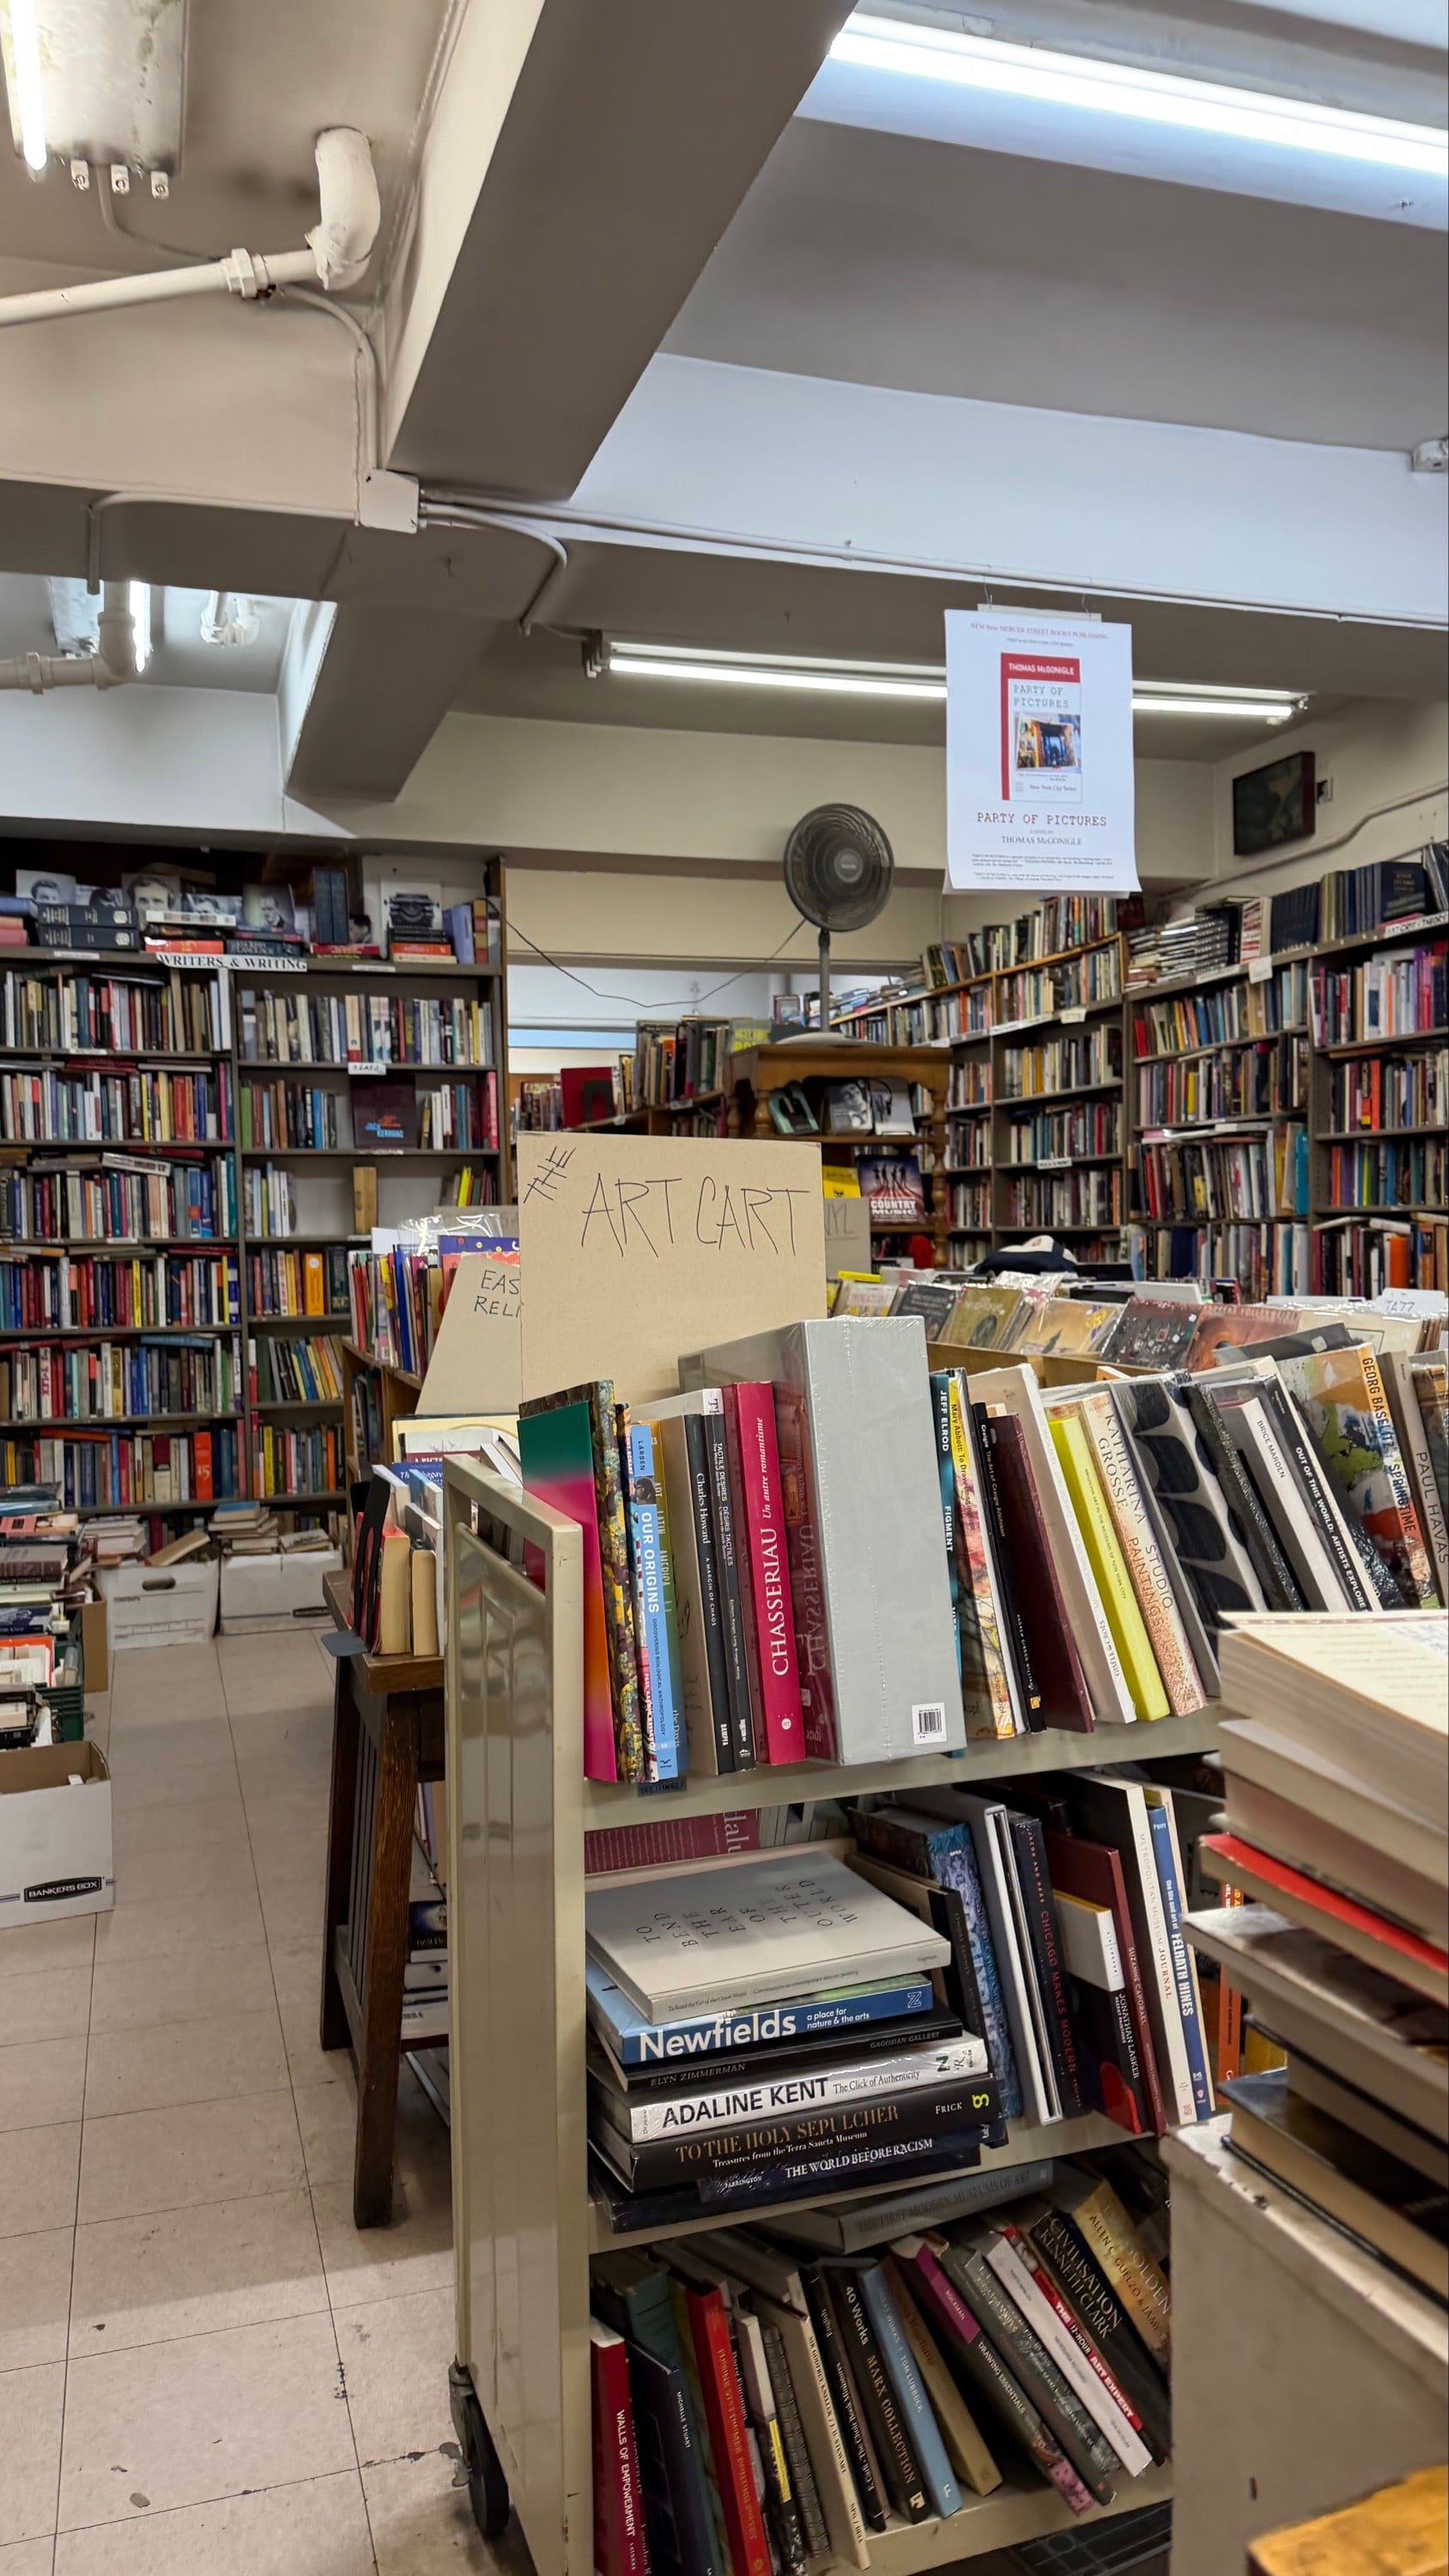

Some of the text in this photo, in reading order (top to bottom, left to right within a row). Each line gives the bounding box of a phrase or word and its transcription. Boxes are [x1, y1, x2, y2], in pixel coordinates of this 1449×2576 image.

[1009, 662, 1035, 672] THOMAS
[1014, 684, 1064, 696] PARTY OF
[1014, 697, 1069, 708] PICTURES
[977, 812, 1106, 826] PARTY OF PICTURES
[1002, 835, 1035, 844] THOMAS
[158, 953, 306, 970] WRITERS & WRITING
[581, 1173, 810, 1257] ART CART
[870, 1200, 916, 1210] COUNTRY
[1362, 1358, 1380, 1394] GEORG
[637, 1440, 646, 1472] LARSEN
[941, 1418, 949, 1452] ELROD
[1257, 1420, 1287, 1479] BRICE MARDEN
[716, 1442, 728, 1501] TACTILE DESIRES
[755, 1418, 773, 1519] Un autre romantisme
[1098, 1437, 1129, 1510] GROSSE
[1105, 1414, 1148, 1525] KATHARINA
[696, 1473, 712, 1545] Charles Howard
[722, 1505, 734, 1566] DÉSIRS TACTILES
[944, 1505, 954, 1552] FIGMENT
[1294, 1447, 1367, 1609] OUT OF THIS WORLD: ARTISTS EXPLORE
[1416, 1451, 1448, 1564] PAUL HAVAS
[641, 1512, 660, 1614] OUR ORIGINS
[1127, 1537, 1166, 1629] PAINTINGS
[1145, 1545, 1174, 1608] STUDIO
[709, 1592, 714, 1601] OF
[762, 1528, 790, 1676] CHASSERIAU
[27, 1879, 99, 1899] BANKERS BOX
[1139, 1832, 1159, 1906] METROPOLITAN
[1158, 1947, 1173, 2000] JOURNAL
[1040, 1910, 1077, 2075] CHICAGO MAKES MODERN
[1126, 1945, 1140, 1986] SUZANNE
[1171, 1934, 1194, 2017] FELRATH HINES
[640, 2009, 797, 2062] Newfields
[807, 2019, 832, 2030] nature
[841, 2014, 853, 2024] the
[855, 2012, 870, 2022] arts
[814, 2010, 834, 2023] place
[835, 2008, 847, 2017] for
[870, 2031, 941, 2049] GAGOSIAN GALLERY
[1118, 1993, 1141, 2081] JONATHAN LASKER
[651, 2063, 746, 2087] ELYN ZIMMERMAN
[662, 2093, 764, 2129] ADALINE
[771, 2077, 828, 2106] KENT
[834, 2069, 921, 2094] The Click of Authenticity
[676, 2105, 899, 2164] TO THE HOLY SEPULCHER
[935, 2100, 963, 2115] FRICK
[713, 2129, 868, 2168] Treasures from the Terra Sancta Museum
[785, 2137, 933, 2179] THE WORLD BEFORE RACISM
[1088, 2215, 1110, 2246] ALLEN
[1040, 2230, 1084, 2294] KENNETH
[1079, 2293, 1113, 2338] CLARK
[1051, 2218, 1123, 2329] CIVILISATION
[846, 2286, 869, 2347] 40 Works
[811, 2349, 824, 2382] GODFREY
[819, 2385, 833, 2416] KNELLER
[900, 2354, 912, 2377] TOM
[978, 2341, 1028, 2415] DRAWING ESSENTIALS
[1054, 2300, 1071, 2324] THE
[1070, 2324, 1092, 2354] 12-HOUR
[1088, 2355, 1108, 2380] ART
[1104, 2378, 1134, 2419] EXPERT
[867, 2354, 887, 2397] MARX
[882, 2398, 915, 2484] COLLECTION
[615, 2409, 636, 2537] WALLS OF EMPOWERMENT
